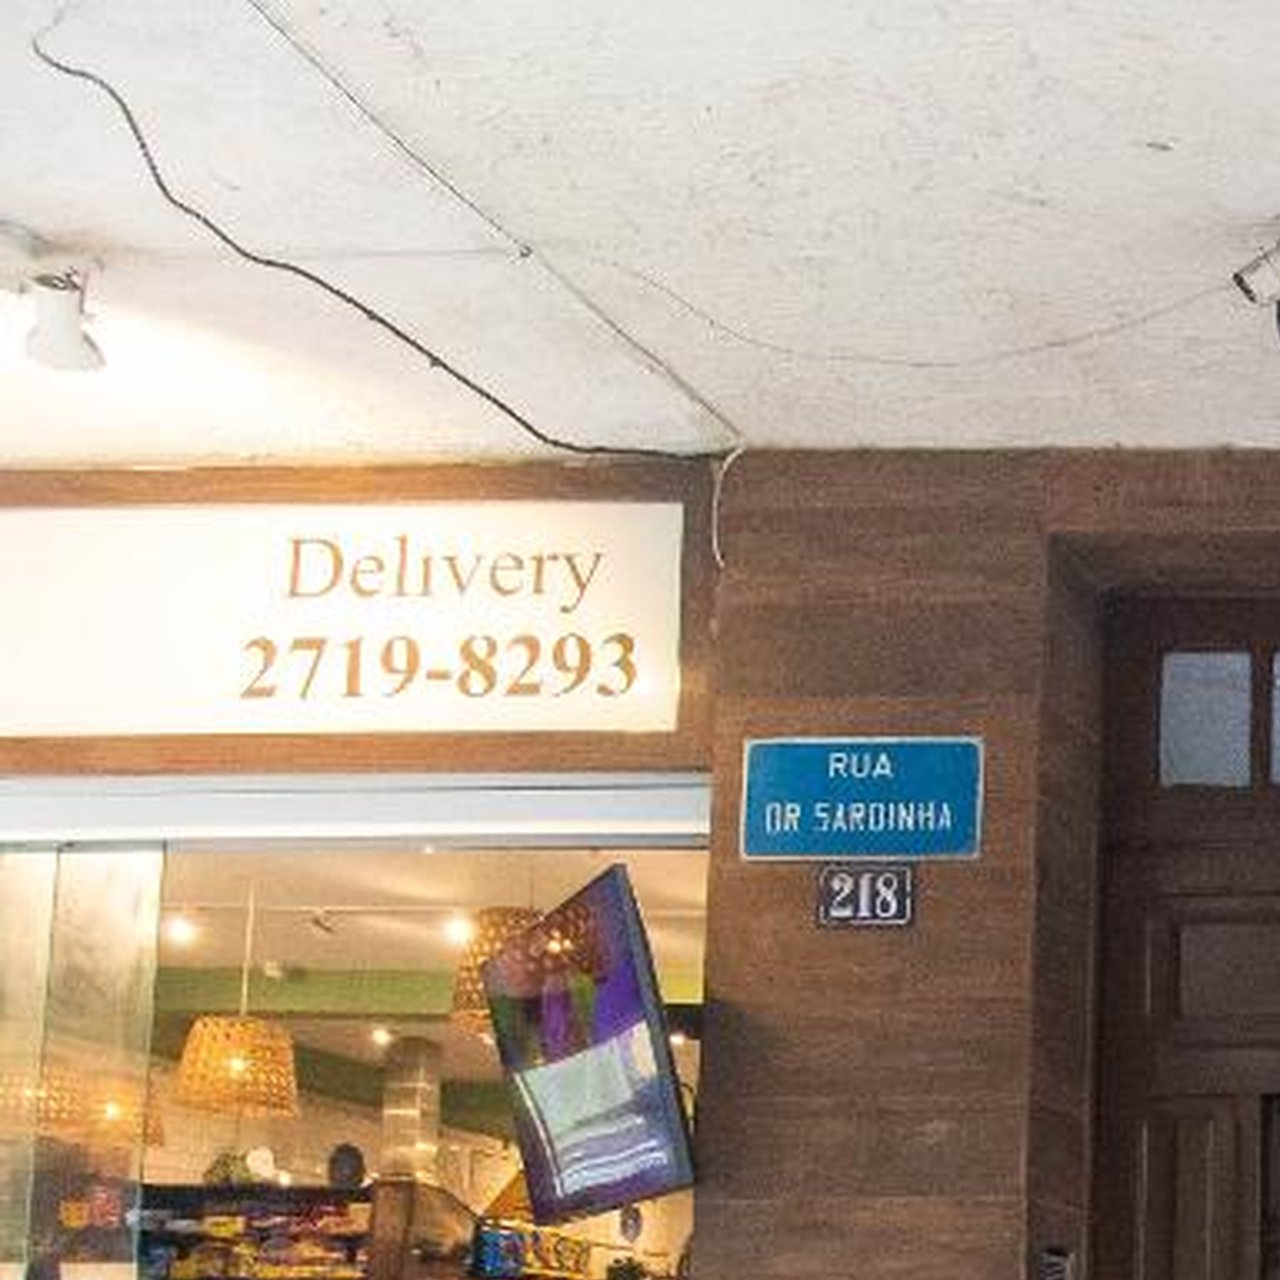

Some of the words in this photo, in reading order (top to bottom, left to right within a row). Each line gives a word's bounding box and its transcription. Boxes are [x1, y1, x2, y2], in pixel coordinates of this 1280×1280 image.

[288, 534, 604, 613] Delivery
[240, 633, 638, 699] 2719-8293
[828, 751, 894, 778] RUA
[814, 802, 951, 832] SARDINHA
[829, 873, 899, 918] 218
